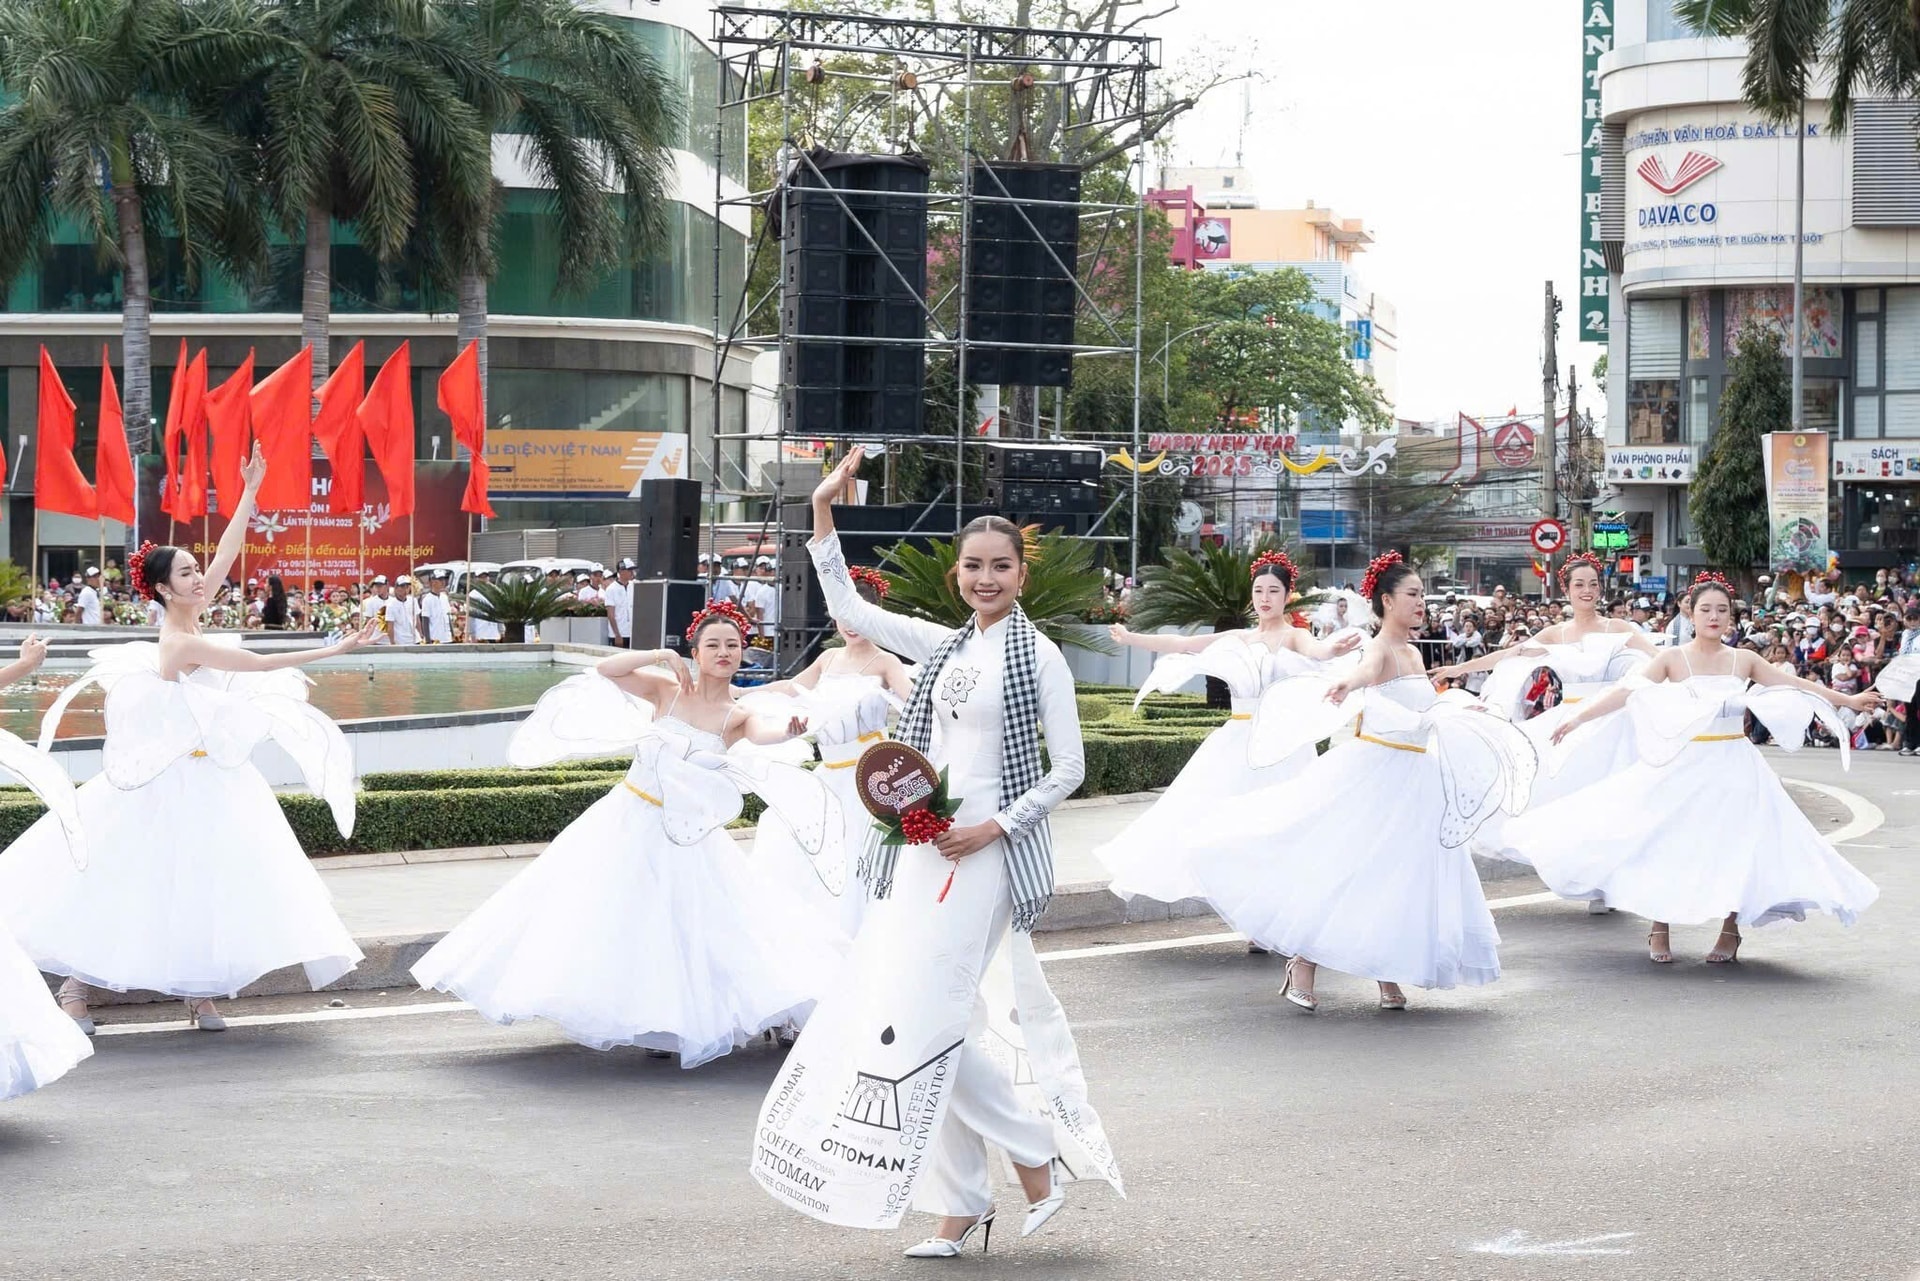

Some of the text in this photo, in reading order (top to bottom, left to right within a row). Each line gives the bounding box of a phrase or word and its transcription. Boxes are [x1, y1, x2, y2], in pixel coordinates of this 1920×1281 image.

[1638, 203, 1717, 228] DAVACO
[1585, 310, 1605, 330] 2
[503, 442, 546, 458] ĐIỆN
[547, 442, 586, 458] VIỆT
[591, 445, 622, 457] NAM
[1149, 434, 1297, 452] HAPPY NEW YEAR
[1871, 445, 1899, 459] SÁCH
[1191, 454, 1254, 477] 2025
[1611, 452, 1630, 465] VĂN
[1632, 450, 1663, 465] PHÒNG
[335, 518, 354, 527] 2025
[245, 543, 277, 556] Thuột
[371, 544, 392, 558] phê
[766, 1062, 807, 1124] OTTOMAN
[914, 1055, 950, 1150] CIVILIZATION
[776, 1088, 807, 1131] COFFEE
[899, 1080, 928, 1146] COFFEE
[759, 1126, 804, 1161] COFFEE
[820, 1138, 906, 1173] OTTOMAN
[774, 1180, 830, 1214] CIVILIZATION
